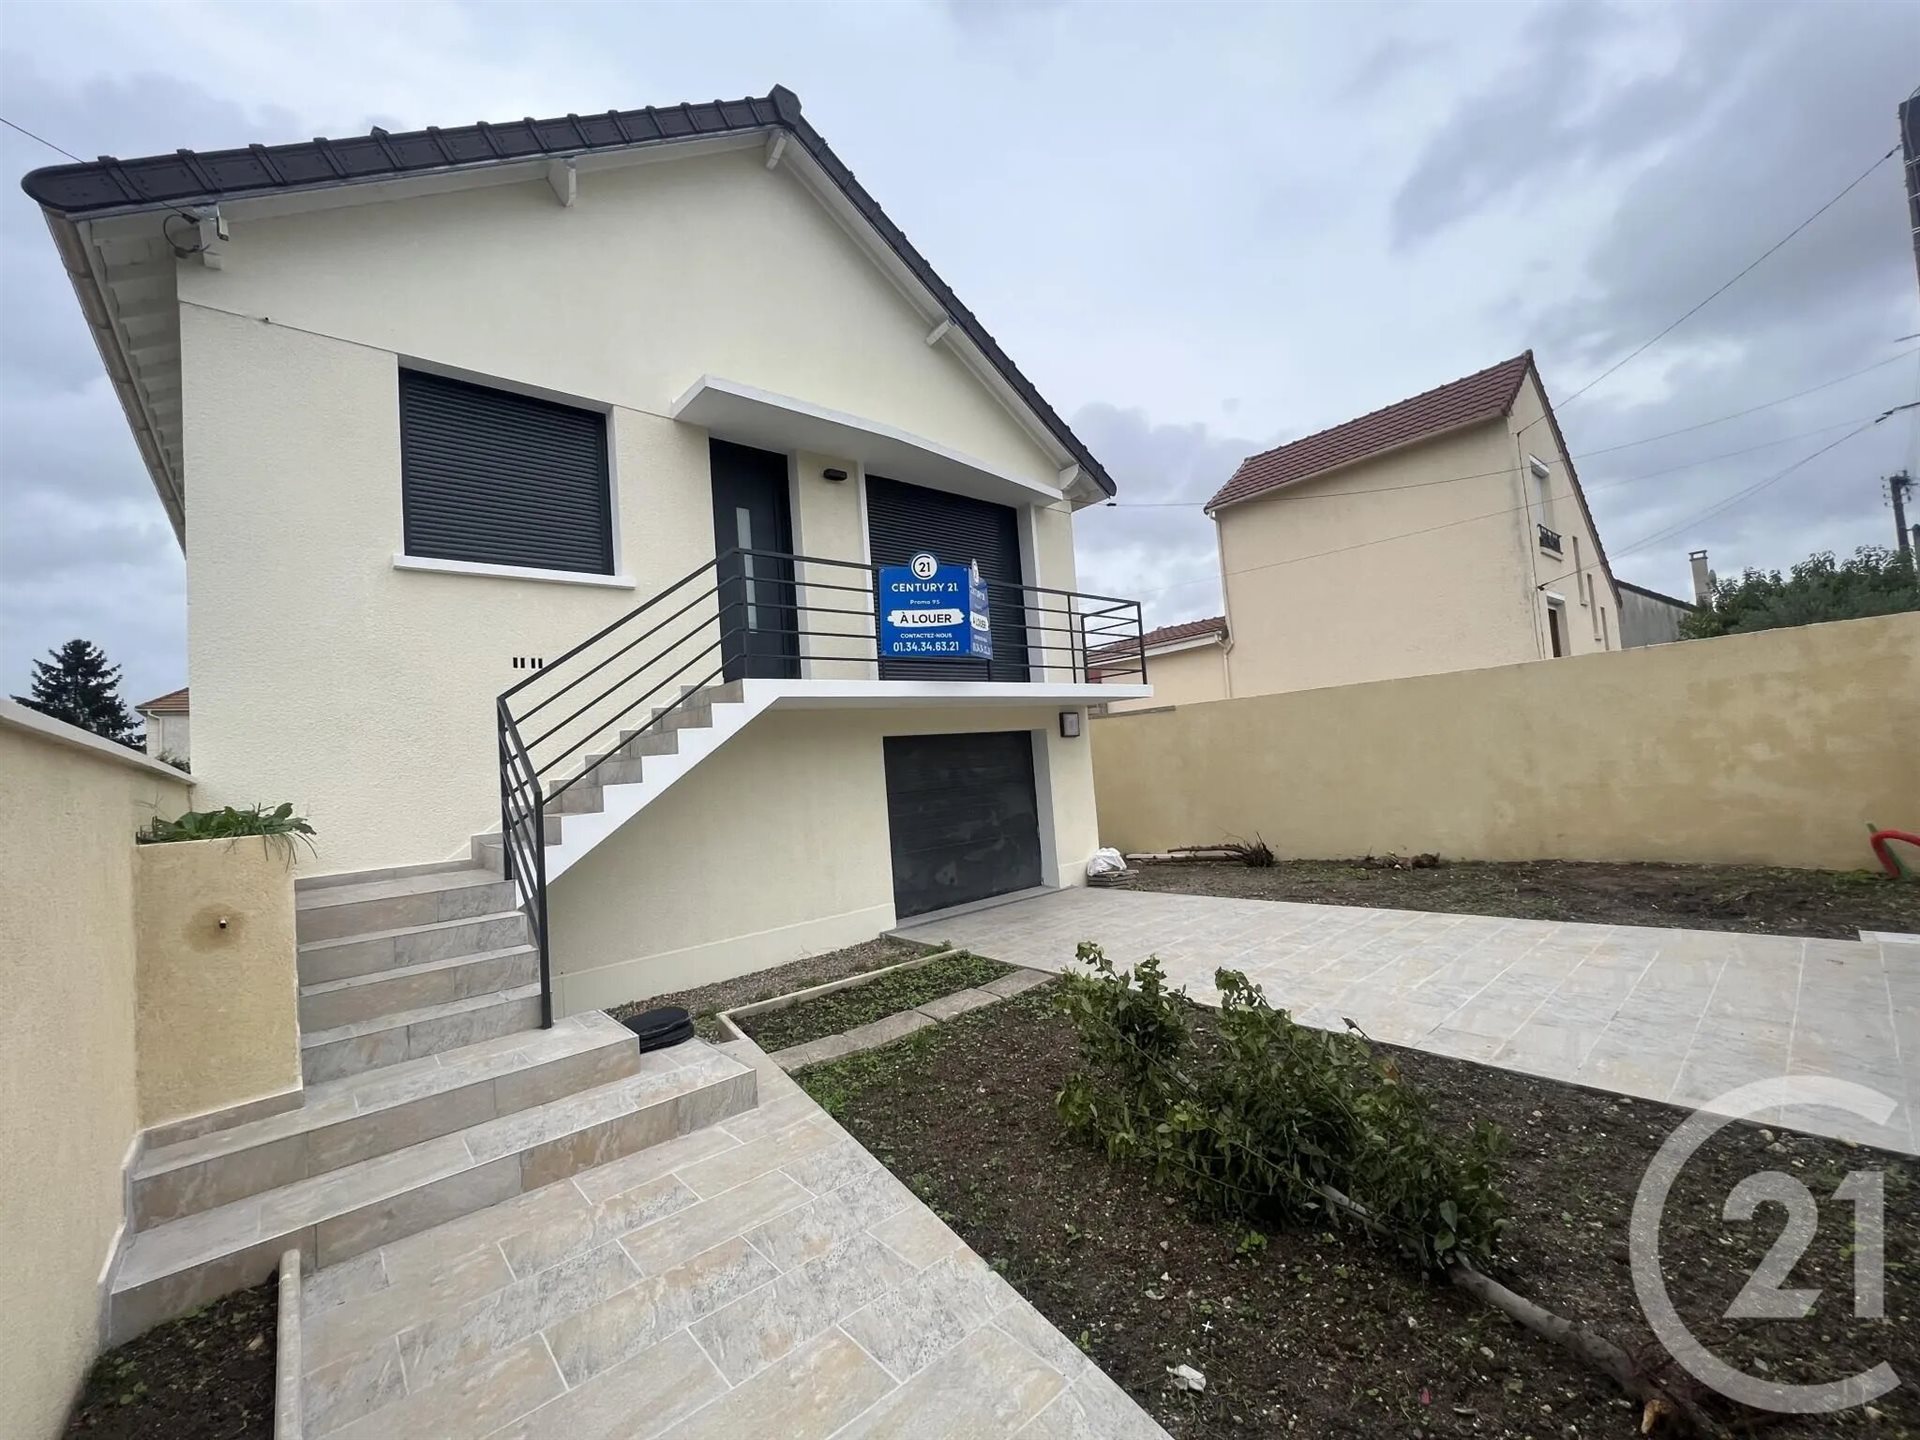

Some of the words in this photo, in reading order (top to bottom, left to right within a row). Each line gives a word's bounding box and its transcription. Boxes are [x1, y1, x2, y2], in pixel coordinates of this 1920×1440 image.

[891, 583, 944, 592] CENTURY
[947, 583, 958, 592] 21
[900, 612, 909, 624] À
[911, 613, 952, 624] LOUER
[893, 641, 959, 652] 01.34.34.63.21
